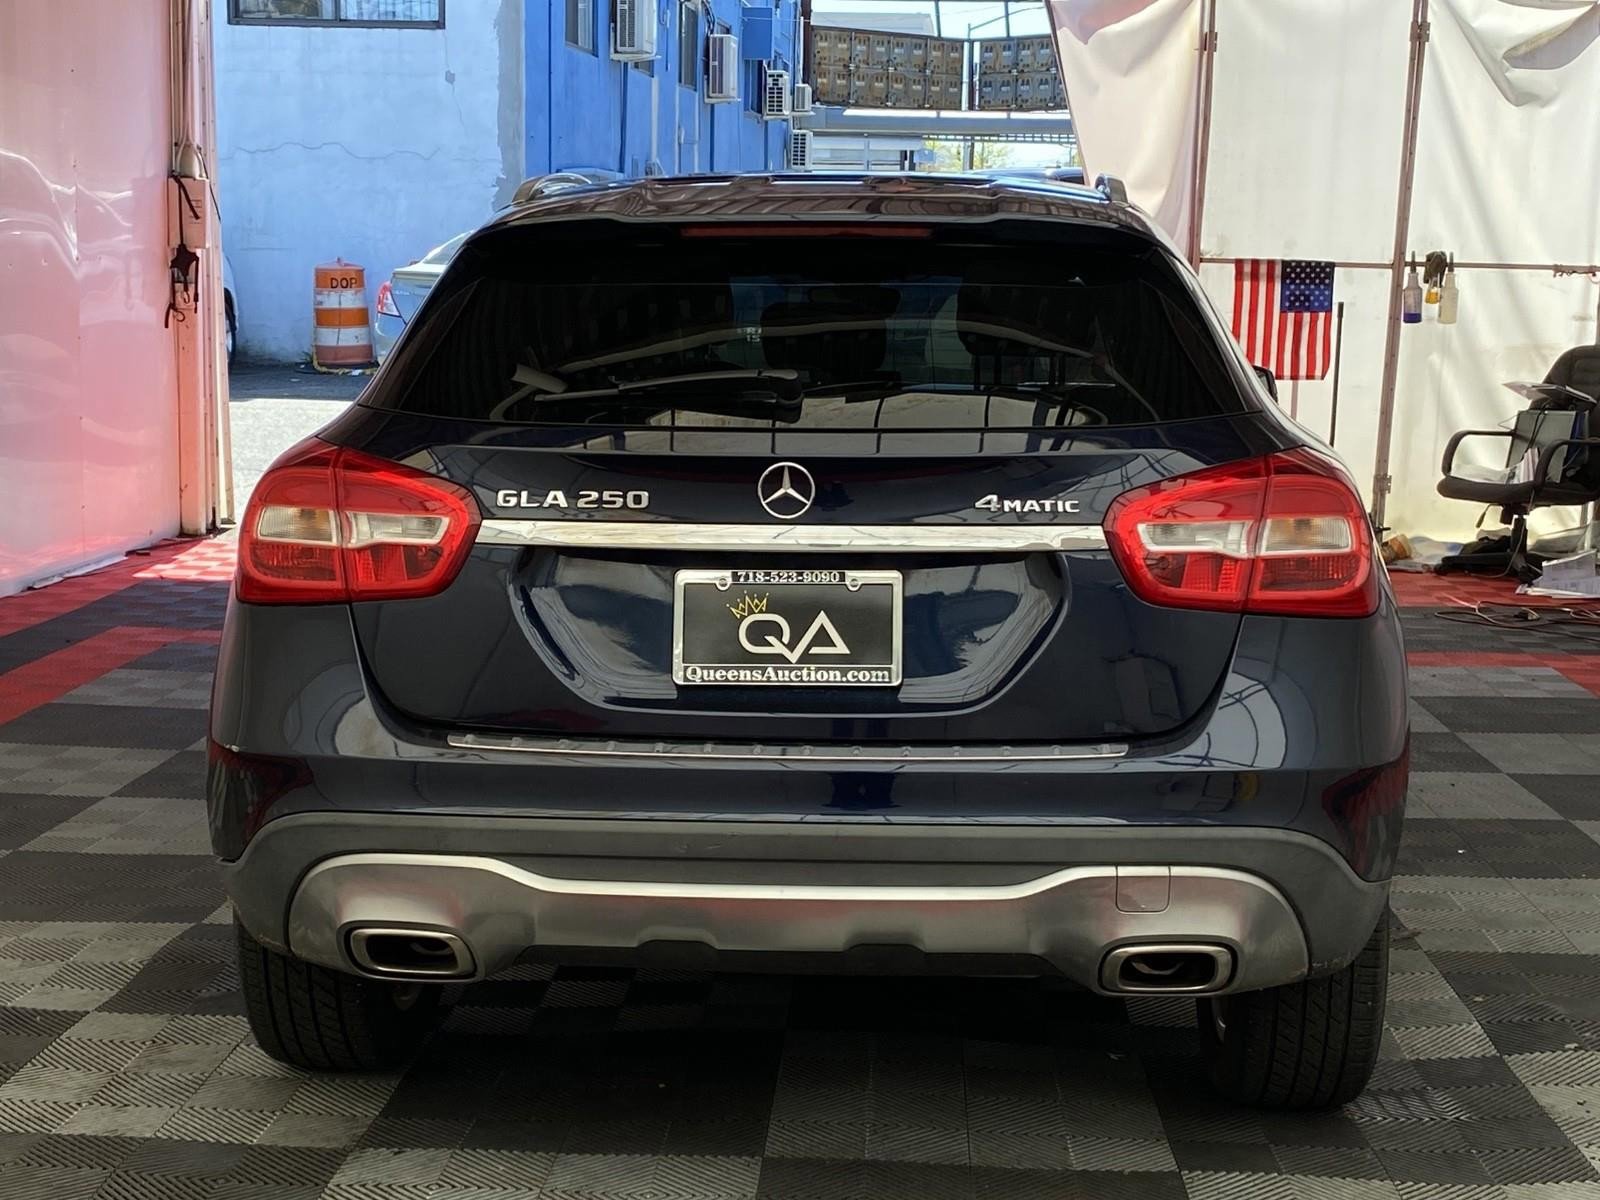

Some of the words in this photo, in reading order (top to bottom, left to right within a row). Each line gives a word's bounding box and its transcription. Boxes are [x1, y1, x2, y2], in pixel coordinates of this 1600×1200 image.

[330, 277, 357, 289] DOP
[496, 490, 568, 508] GLA
[577, 490, 649, 508] 250
[974, 494, 1080, 513] 4MATIC
[738, 571, 840, 583] 718-523-9090
[738, 610, 851, 664] QA
[686, 666, 889, 682] QueensAuction.com
